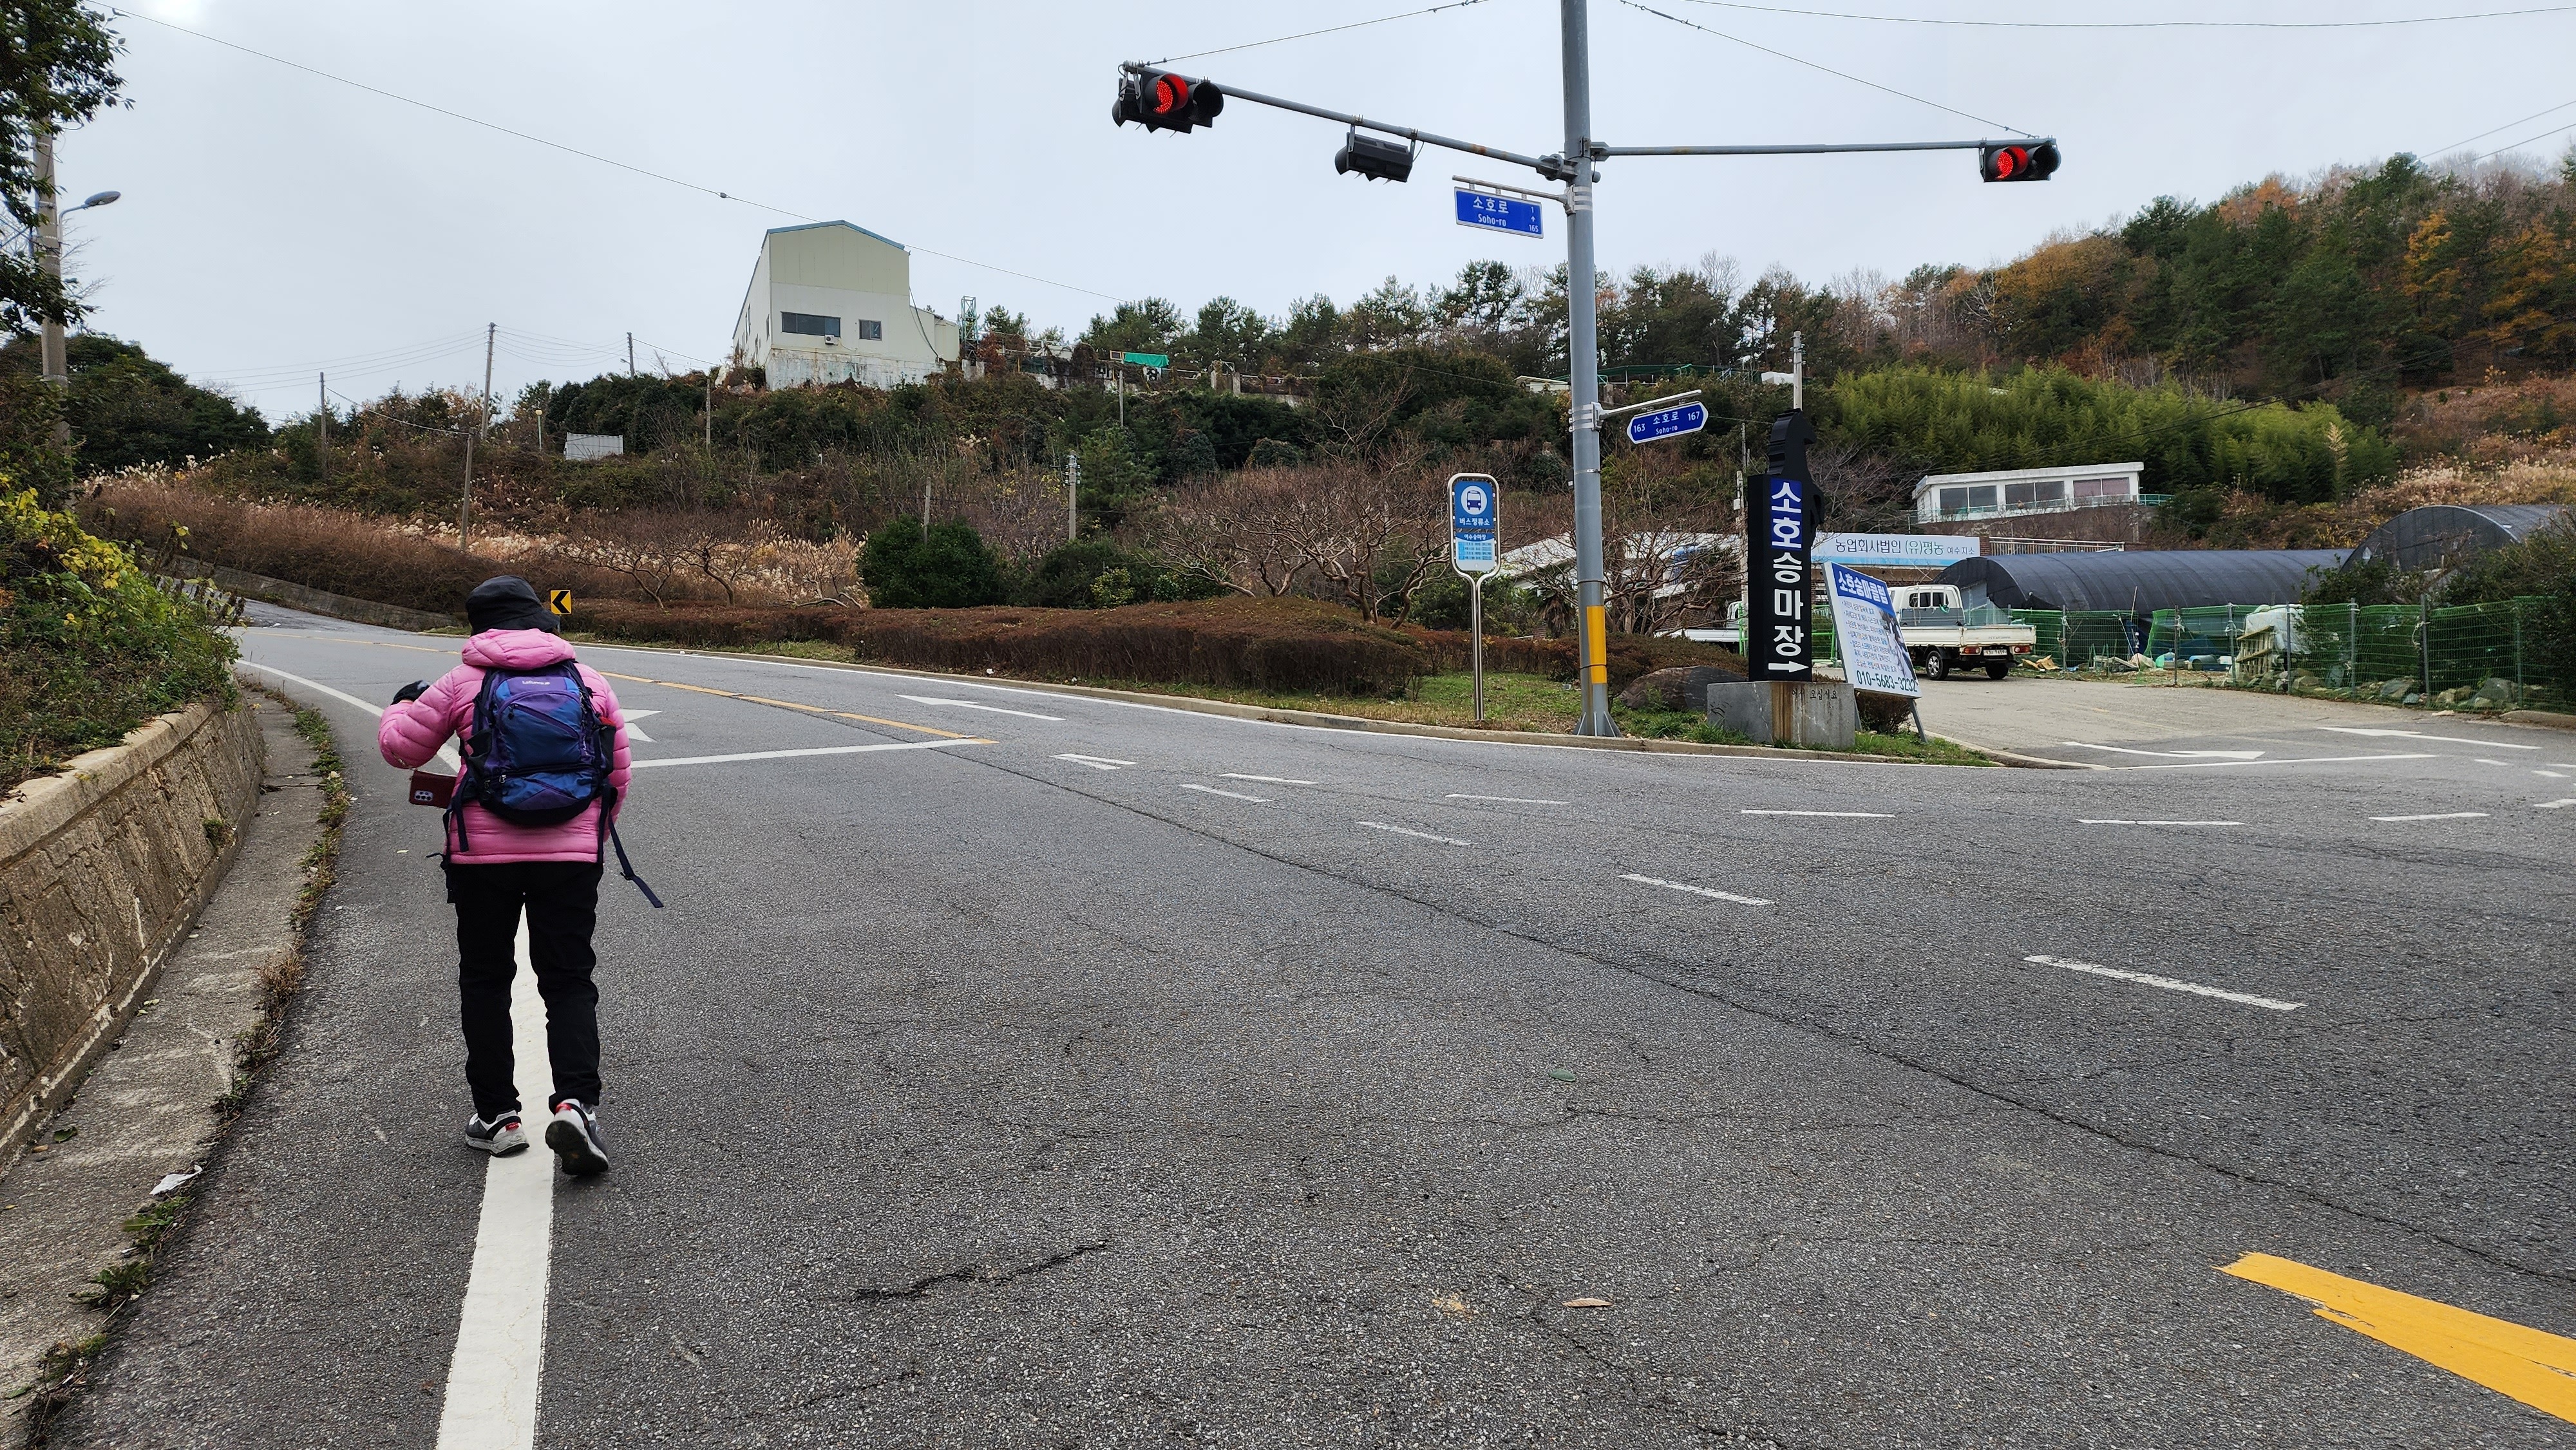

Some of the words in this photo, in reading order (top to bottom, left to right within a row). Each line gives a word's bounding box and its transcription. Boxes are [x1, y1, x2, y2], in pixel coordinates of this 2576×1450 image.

[1473, 196, 1509, 214] 소호로
[1478, 213, 1506, 227] Soho-ro
[1529, 224, 1539, 232] 165
[1653, 411, 1680, 425] 소호로
[1687, 411, 1700, 421] 167
[1633, 423, 1645, 433] 163
[1656, 425, 1678, 435] Soho-ro
[1459, 517, 1491, 526] 버스정류소
[1835, 539, 1901, 553] 농업회사법인
[1905, 540, 1944, 555] (유)평농
[1772, 482, 1804, 656] 소호승마장
[1838, 570, 1889, 605] 소호승마클럽
[1857, 670, 1917, 692] 010-5683-3232
